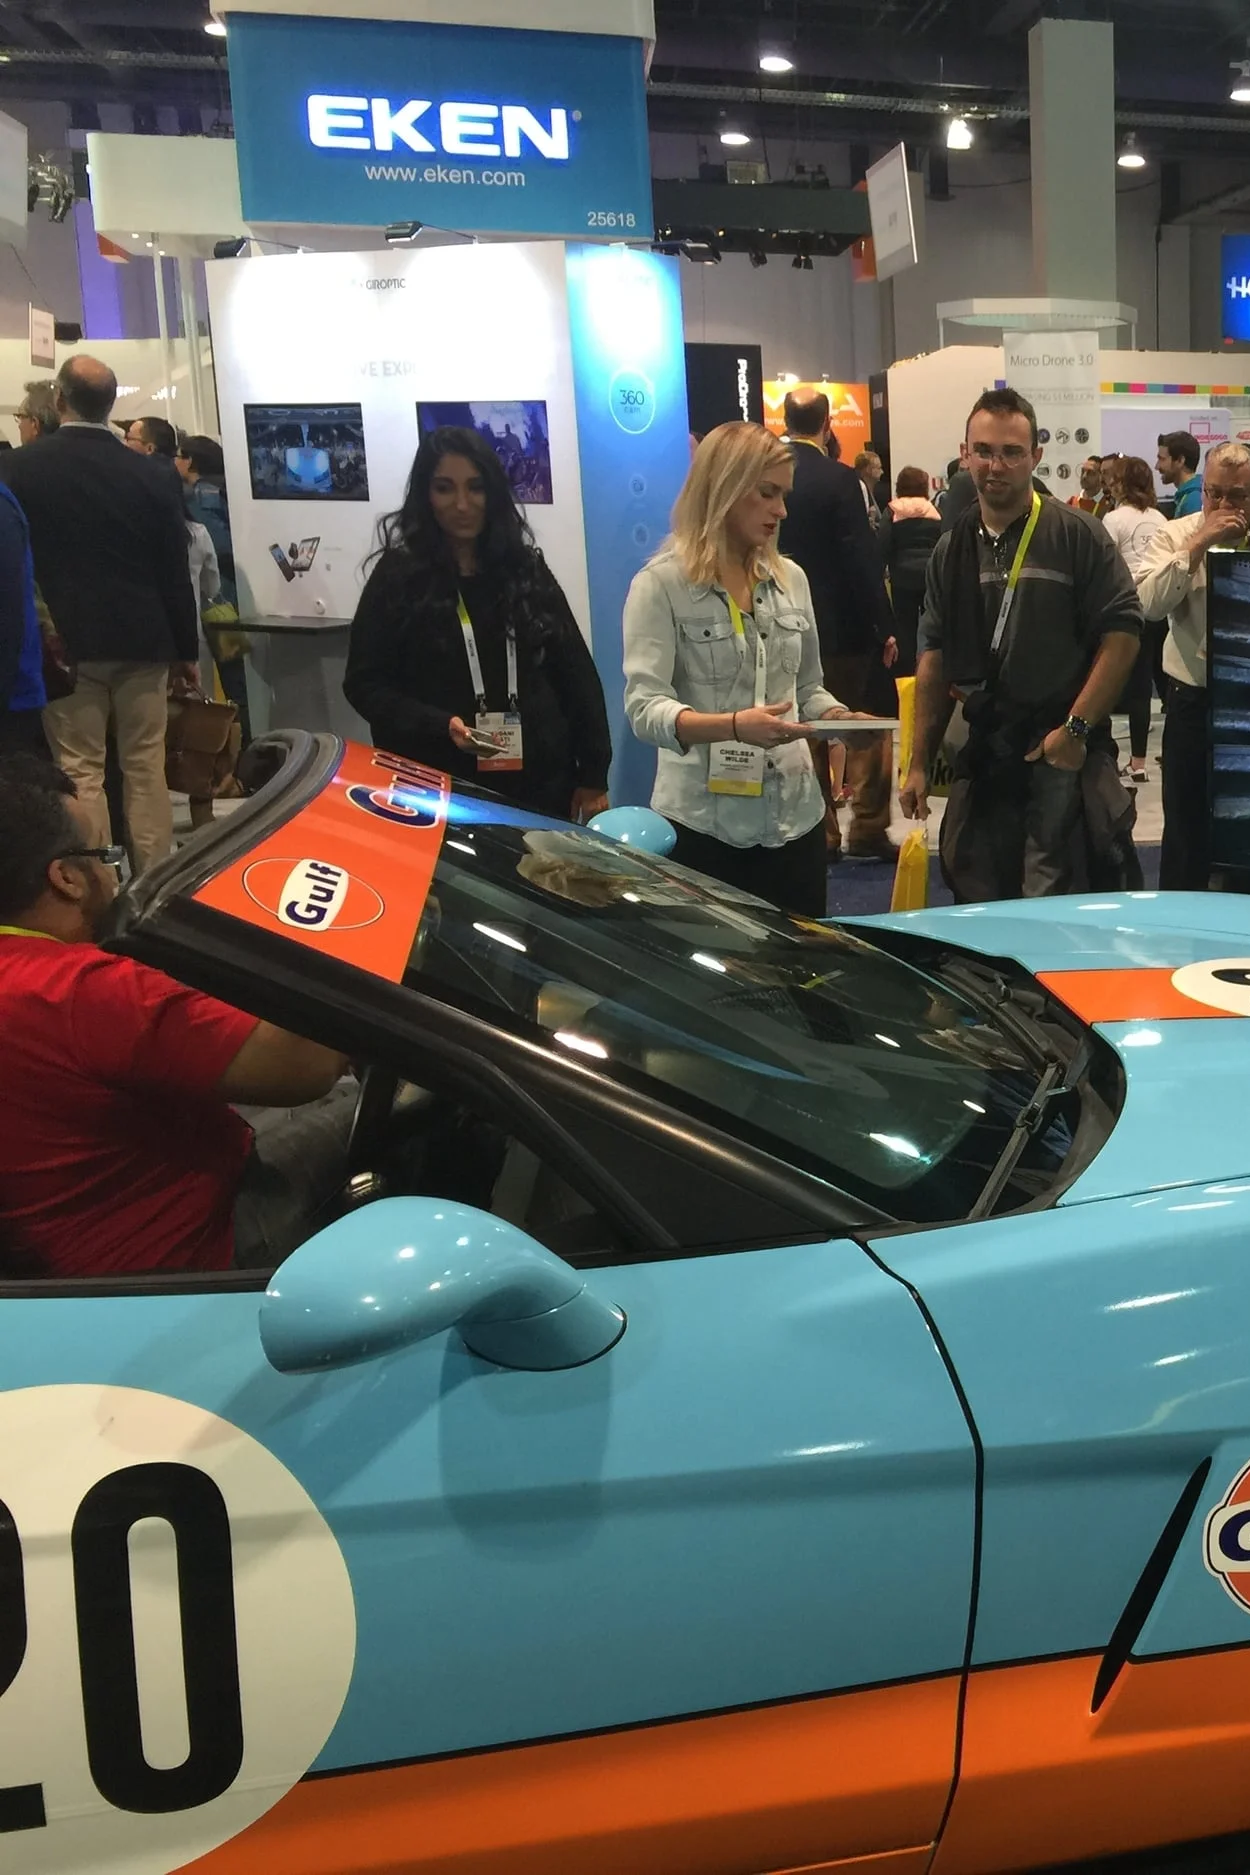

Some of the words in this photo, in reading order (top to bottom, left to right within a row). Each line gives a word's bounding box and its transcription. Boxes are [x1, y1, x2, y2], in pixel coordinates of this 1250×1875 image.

[307, 94, 570, 160] EKEN
[364, 165, 526, 187] www.eken.com
[587, 211, 636, 228] 25618
[1010, 353, 1040, 367] Micro
[1042, 353, 1076, 367] Drone
[1078, 352, 1094, 366] 3.0
[619, 389, 645, 406] 360
[719, 748, 756, 758] CHELSEA
[284, 861, 342, 926] Gulf
